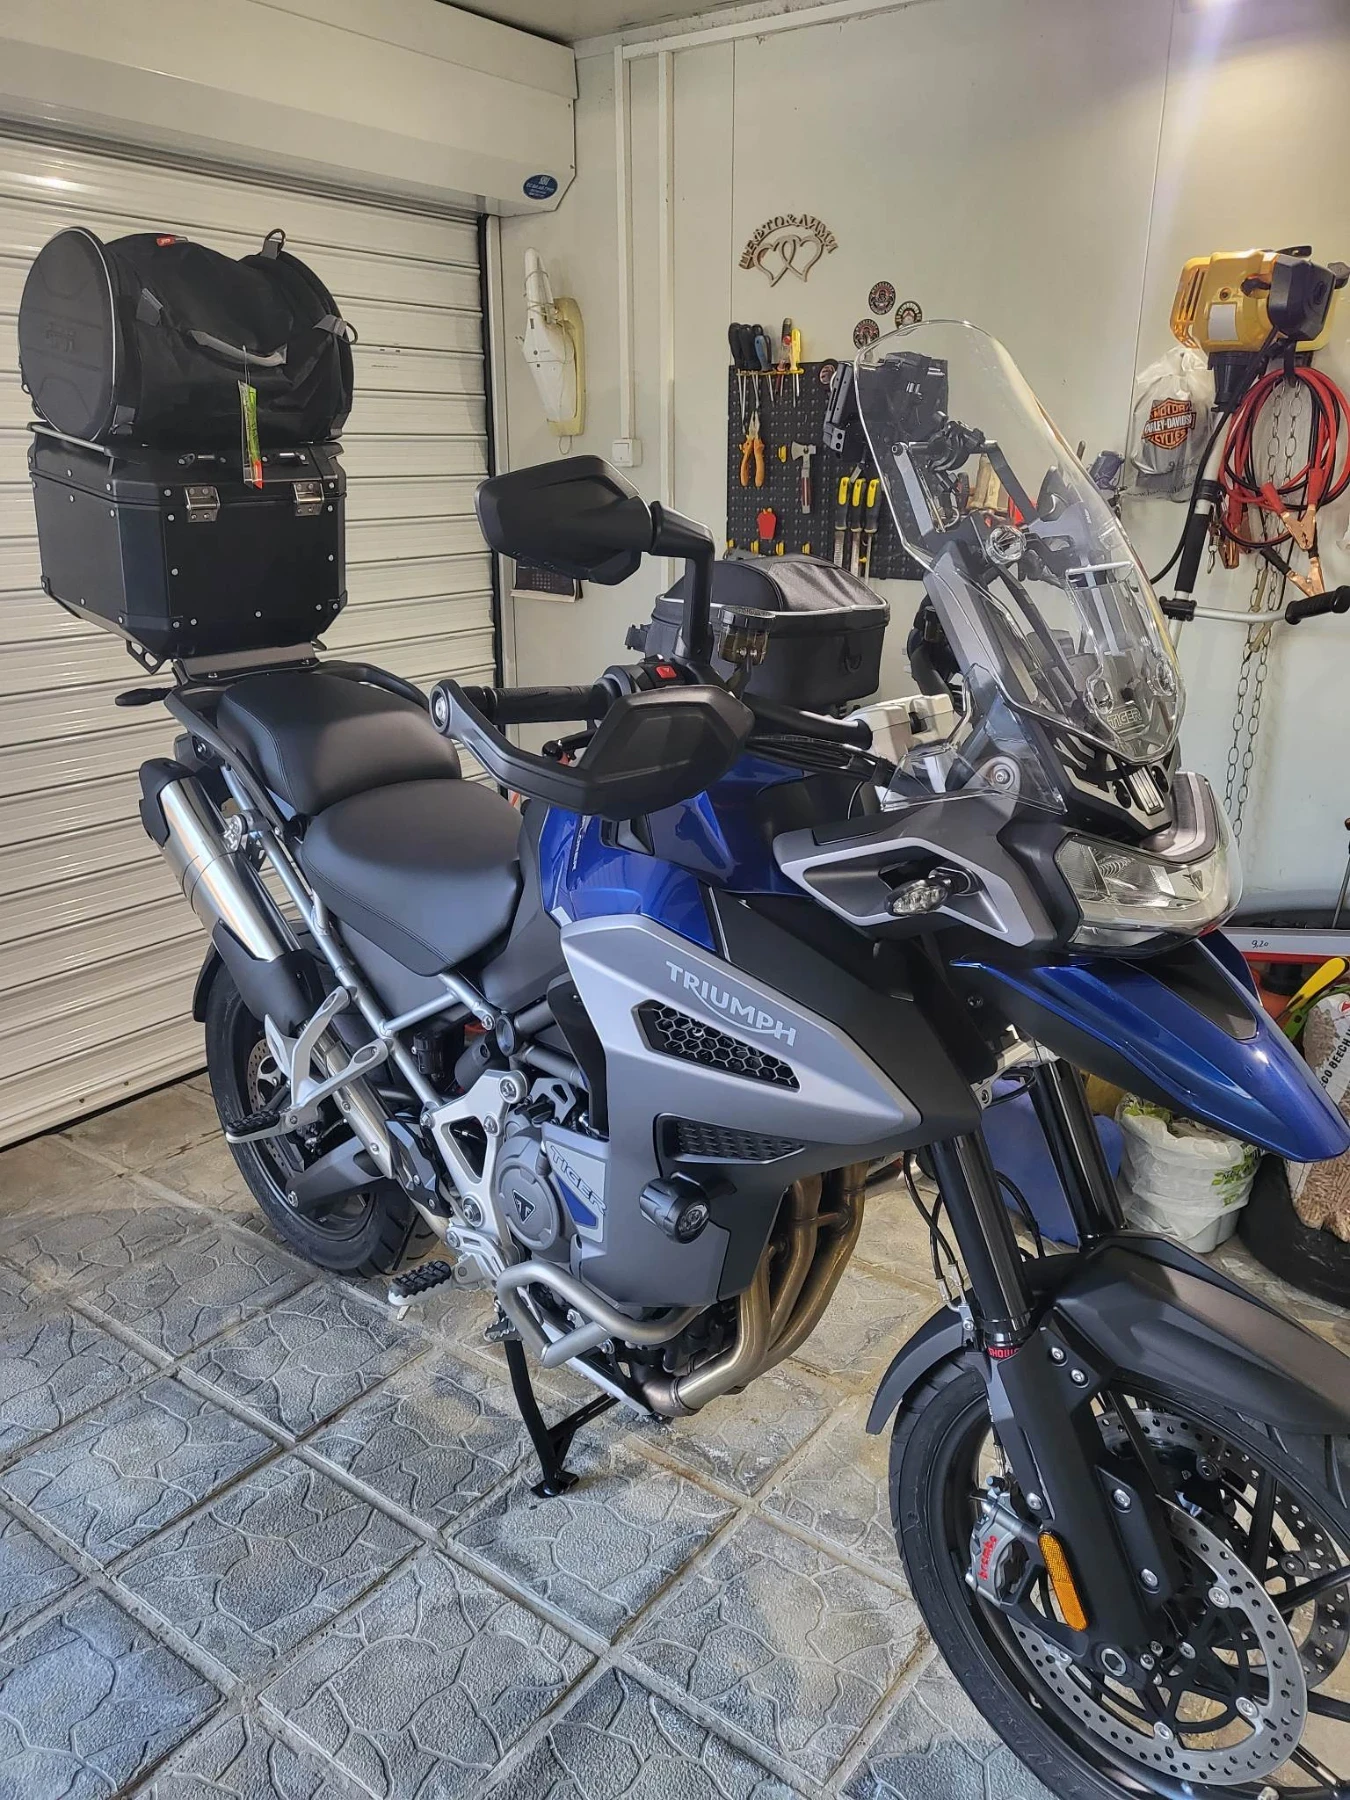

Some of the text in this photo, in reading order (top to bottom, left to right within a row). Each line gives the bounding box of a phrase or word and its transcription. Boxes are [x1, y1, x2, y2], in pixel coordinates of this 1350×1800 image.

[1154, 430, 1186, 446] CYCLES
[1107, 708, 1142, 730] TIGER
[666, 960, 797, 1047] TRIUMPH
[1329, 1038, 1350, 1069] BEECH
[550, 1144, 608, 1216] TIGER
[977, 1535, 997, 1581] brembo
